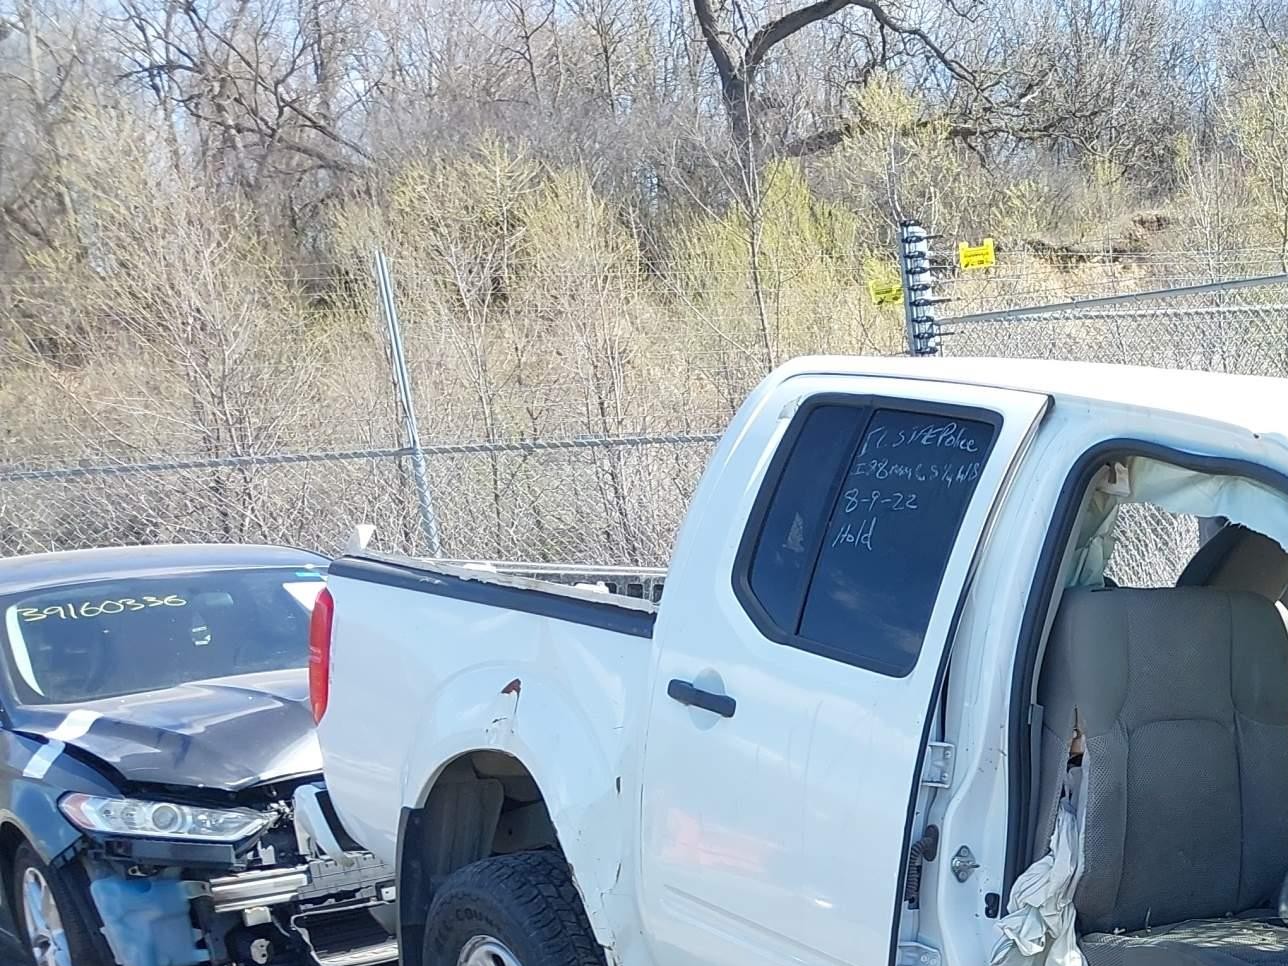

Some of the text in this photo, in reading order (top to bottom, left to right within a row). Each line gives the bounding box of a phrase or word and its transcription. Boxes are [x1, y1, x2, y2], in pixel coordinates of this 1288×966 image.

[844, 488, 918, 512] 8-9-22
[832, 516, 878, 551] Hold
[15, 593, 188, 623] 39160336
